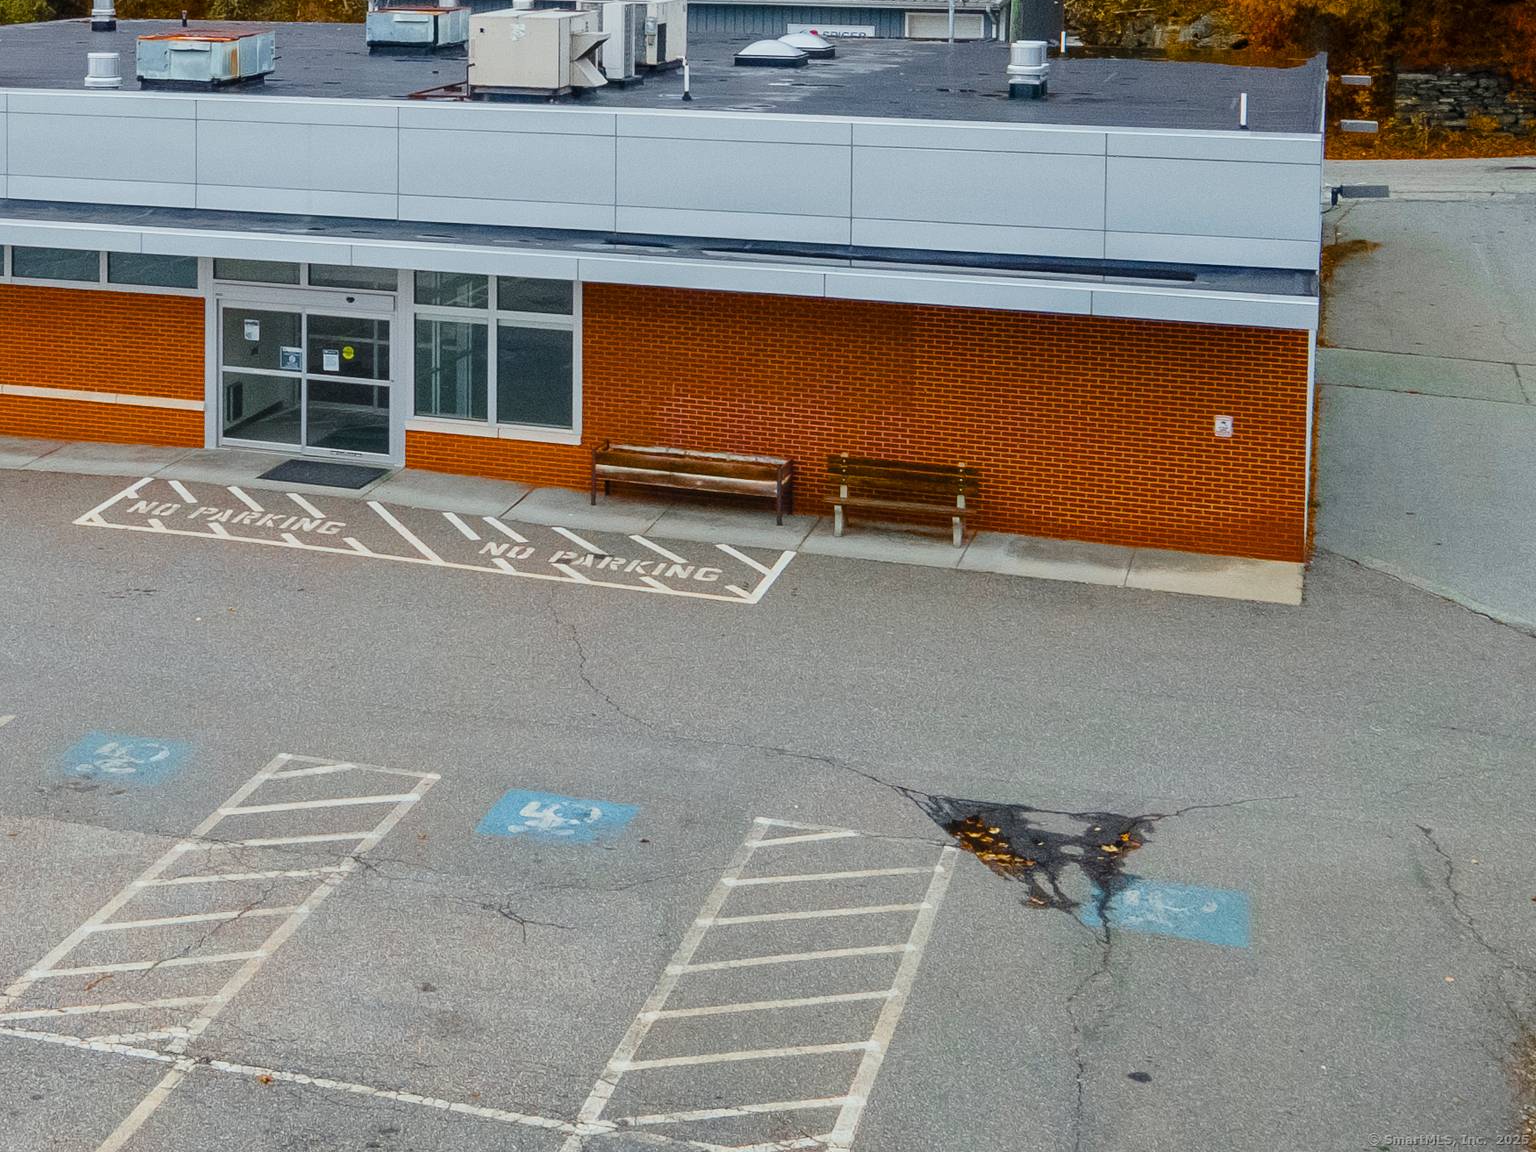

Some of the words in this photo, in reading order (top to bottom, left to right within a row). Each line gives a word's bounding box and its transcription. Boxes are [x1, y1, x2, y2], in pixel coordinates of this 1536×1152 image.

[127, 500, 181, 516] NO
[188, 506, 346, 535] PARKING
[479, 541, 536, 559] NO
[549, 550, 723, 582] PARKING
